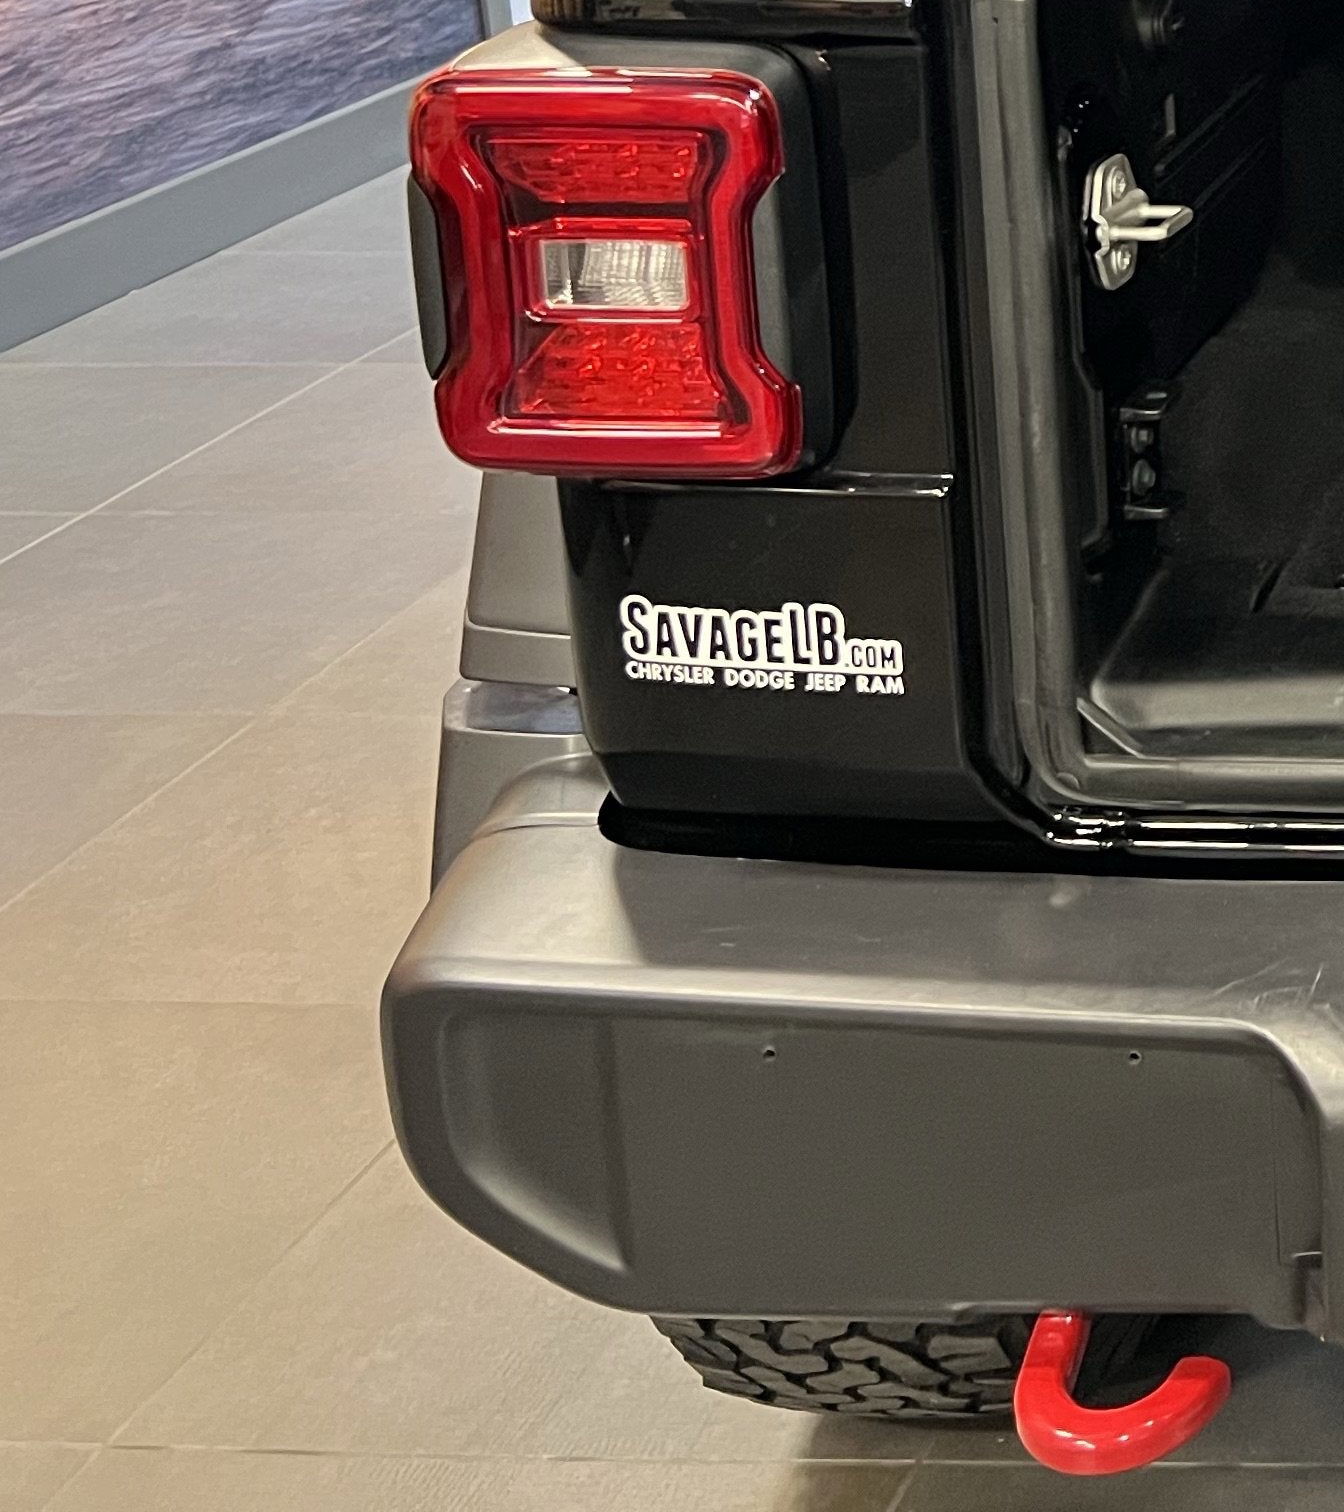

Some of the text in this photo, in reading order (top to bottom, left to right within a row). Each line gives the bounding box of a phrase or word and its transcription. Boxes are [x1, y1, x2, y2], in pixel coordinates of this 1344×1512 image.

[625, 661, 905, 695] CHRYSLER DODGE JEEP RAM
